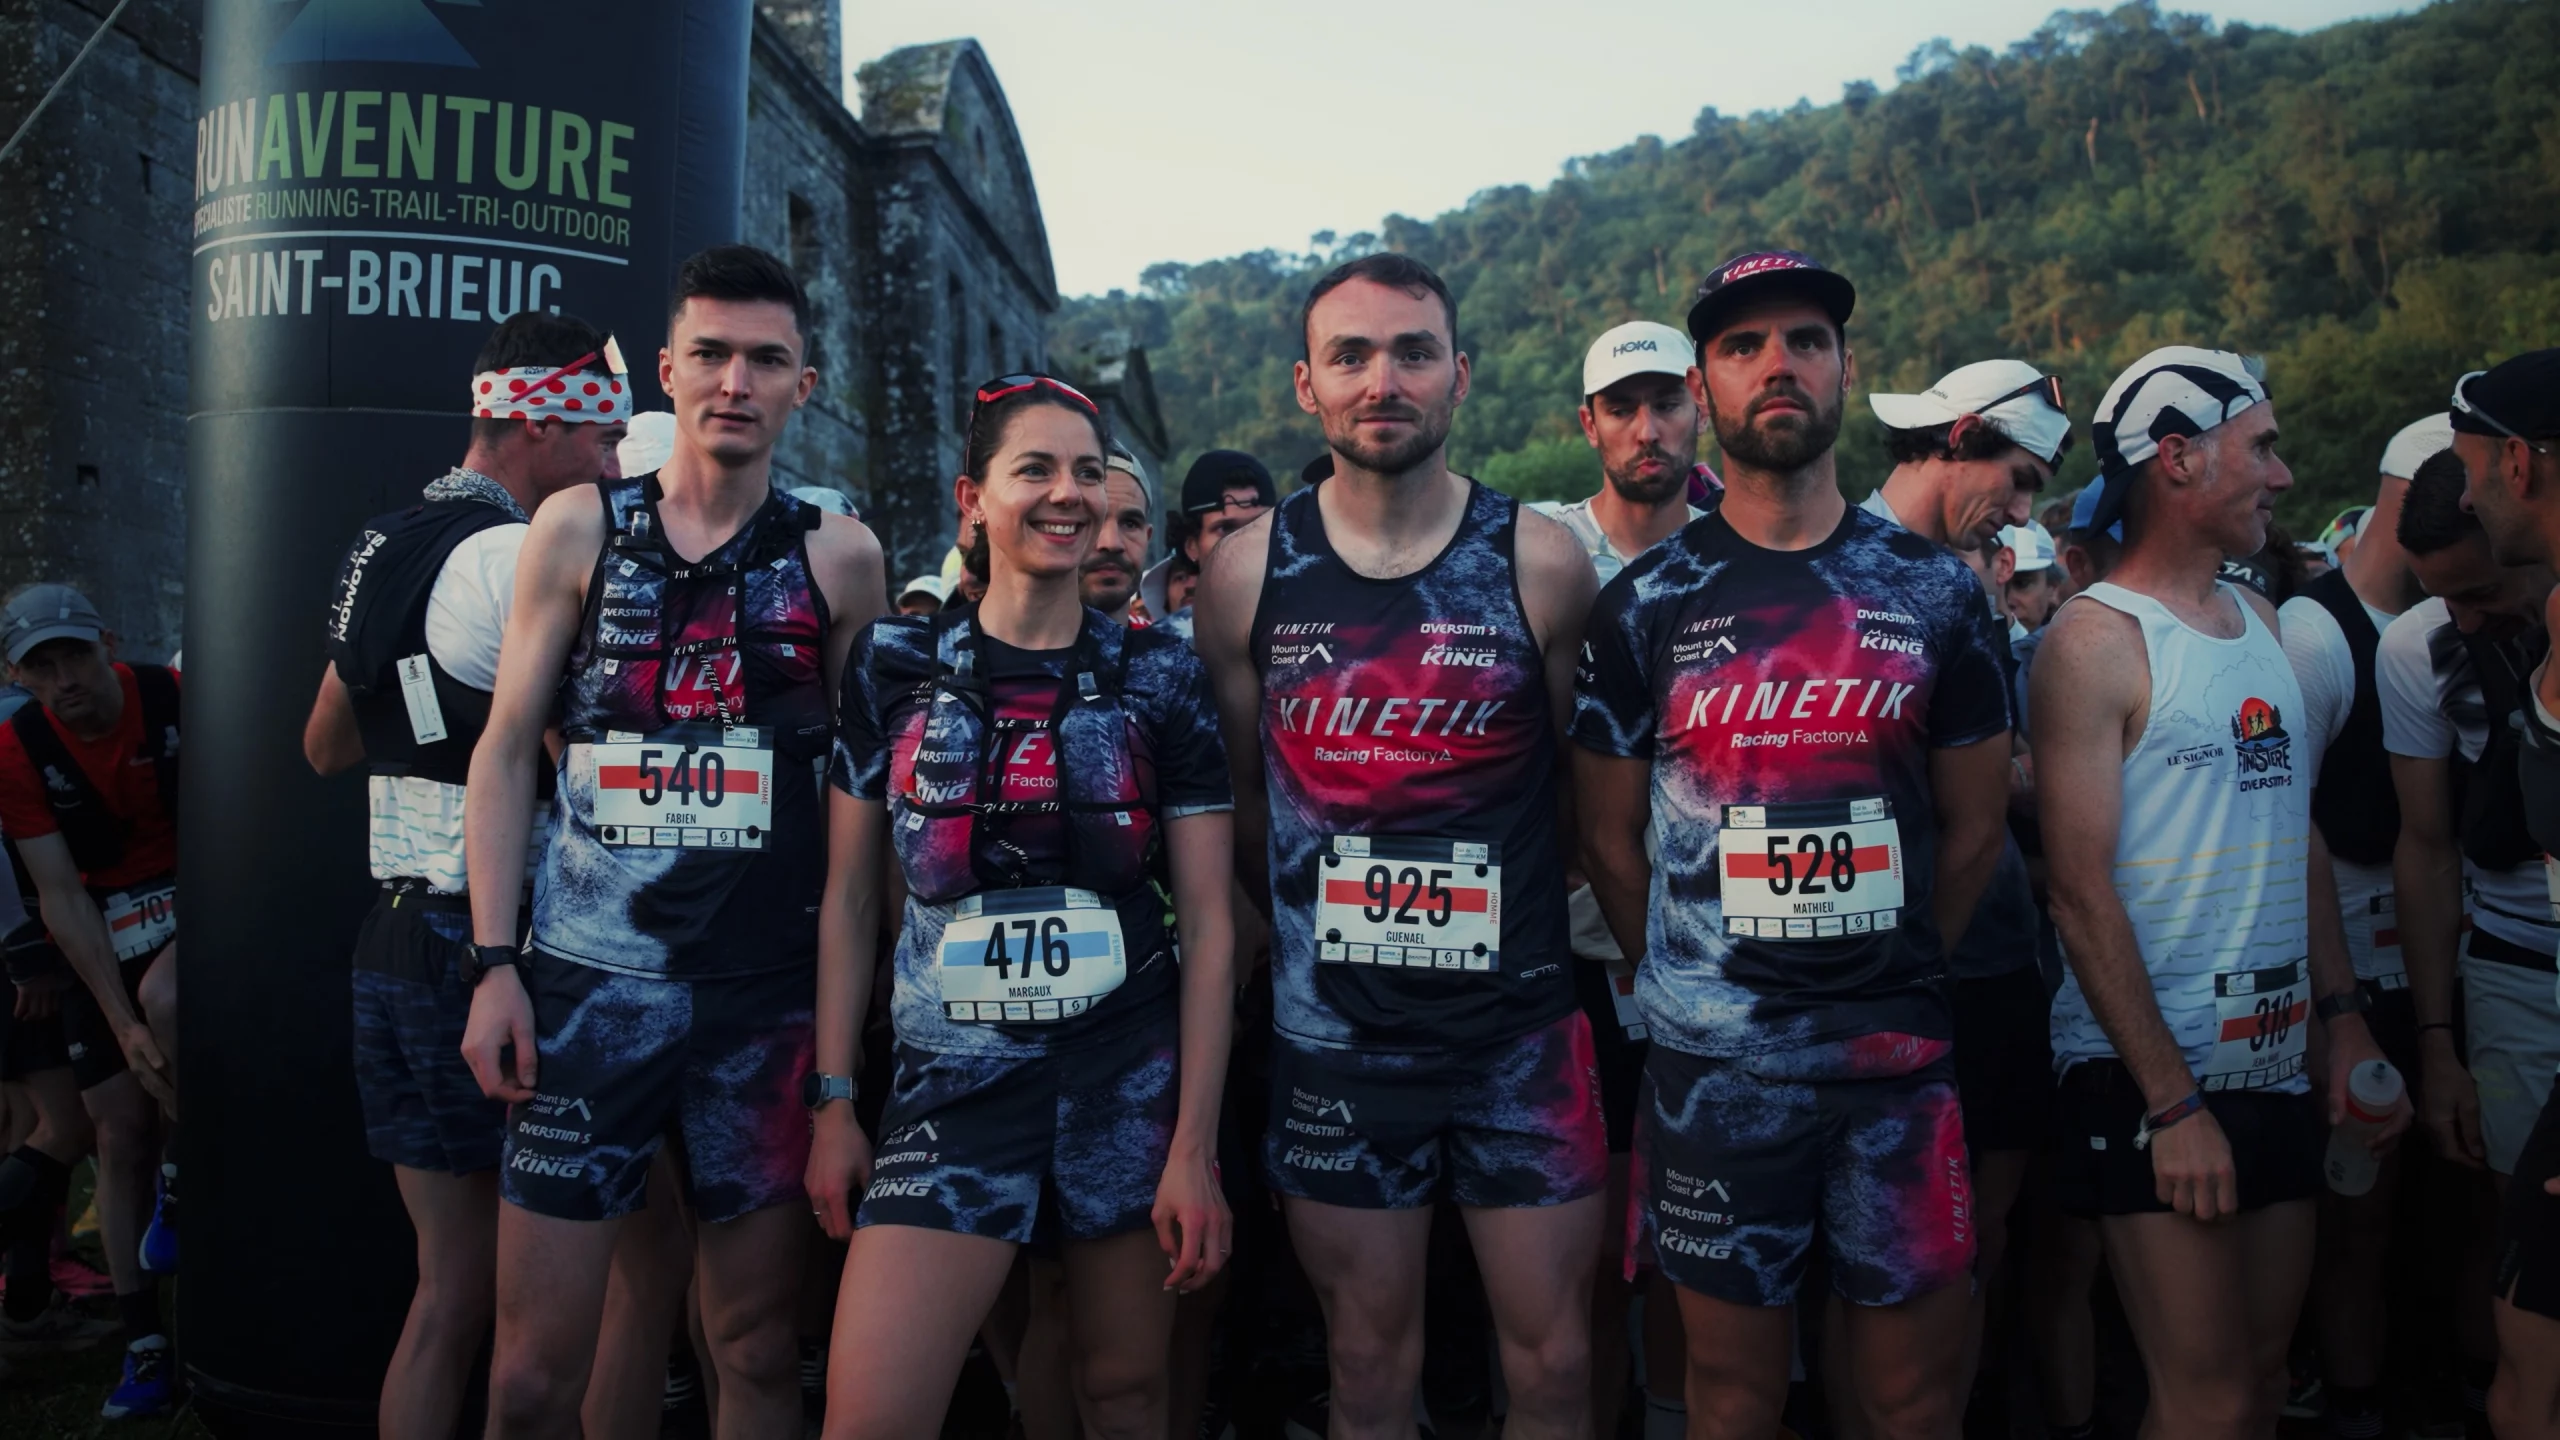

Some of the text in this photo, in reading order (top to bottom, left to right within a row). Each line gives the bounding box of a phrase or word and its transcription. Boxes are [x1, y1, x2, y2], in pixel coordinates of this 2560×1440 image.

[195, 91, 635, 209] RUNAVENTURE
[255, 187, 631, 248] RUNNING-TRAIL-TRI-OUTDOOR
[1613, 340, 1658, 358] HOKA
[338, 533, 388, 643] SALOMON
[600, 633, 658, 645] KING
[1273, 622, 1336, 636] KINETIK
[1271, 644, 1310, 654] Mount to
[1427, 643, 1497, 653] MOUNTAIN
[1673, 639, 1714, 654] Mount to
[1860, 636, 1925, 655] KING
[1271, 655, 1296, 665] Coast
[1420, 652, 1497, 667] KING
[1673, 652, 1700, 664] Coast
[1686, 679, 1916, 730] KINETIK
[1280, 697, 1506, 737] KINETIK
[1731, 729, 1854, 749] Racing Factory
[1315, 746, 1438, 764] Racing Factory
[2167, 747, 2224, 767] LE SIGNOR
[639, 750, 725, 808] 540
[761, 774, 769, 806] HOMME
[665, 812, 697, 825] FABIEN
[1767, 831, 1856, 896] 528
[1891, 846, 1900, 881] HOMME
[1363, 864, 1453, 928] 925
[1489, 892, 1498, 925] HOMME
[1793, 901, 1834, 914] MATHIEU
[1386, 930, 1426, 945] GUENAEL
[983, 916, 1071, 980] 476
[1111, 934, 1123, 967] FEMME
[1008, 985, 1052, 998] MARGAUX
[2249, 990, 2293, 1053] 318
[536, 1093, 570, 1106] ount to
[1291, 1098, 1315, 1114] Coast
[1293, 1086, 1331, 1107] Mount to
[528, 1103, 553, 1115] oast
[510, 1153, 585, 1179] KING
[1283, 1149, 1358, 1171] KING
[1666, 1167, 1705, 1188] Mount to
[1666, 1179, 1691, 1196] Coast
[864, 1181, 934, 1202] KING
[1946, 1156, 1965, 1244] KINETIK
[1660, 1231, 1733, 1260] KING
